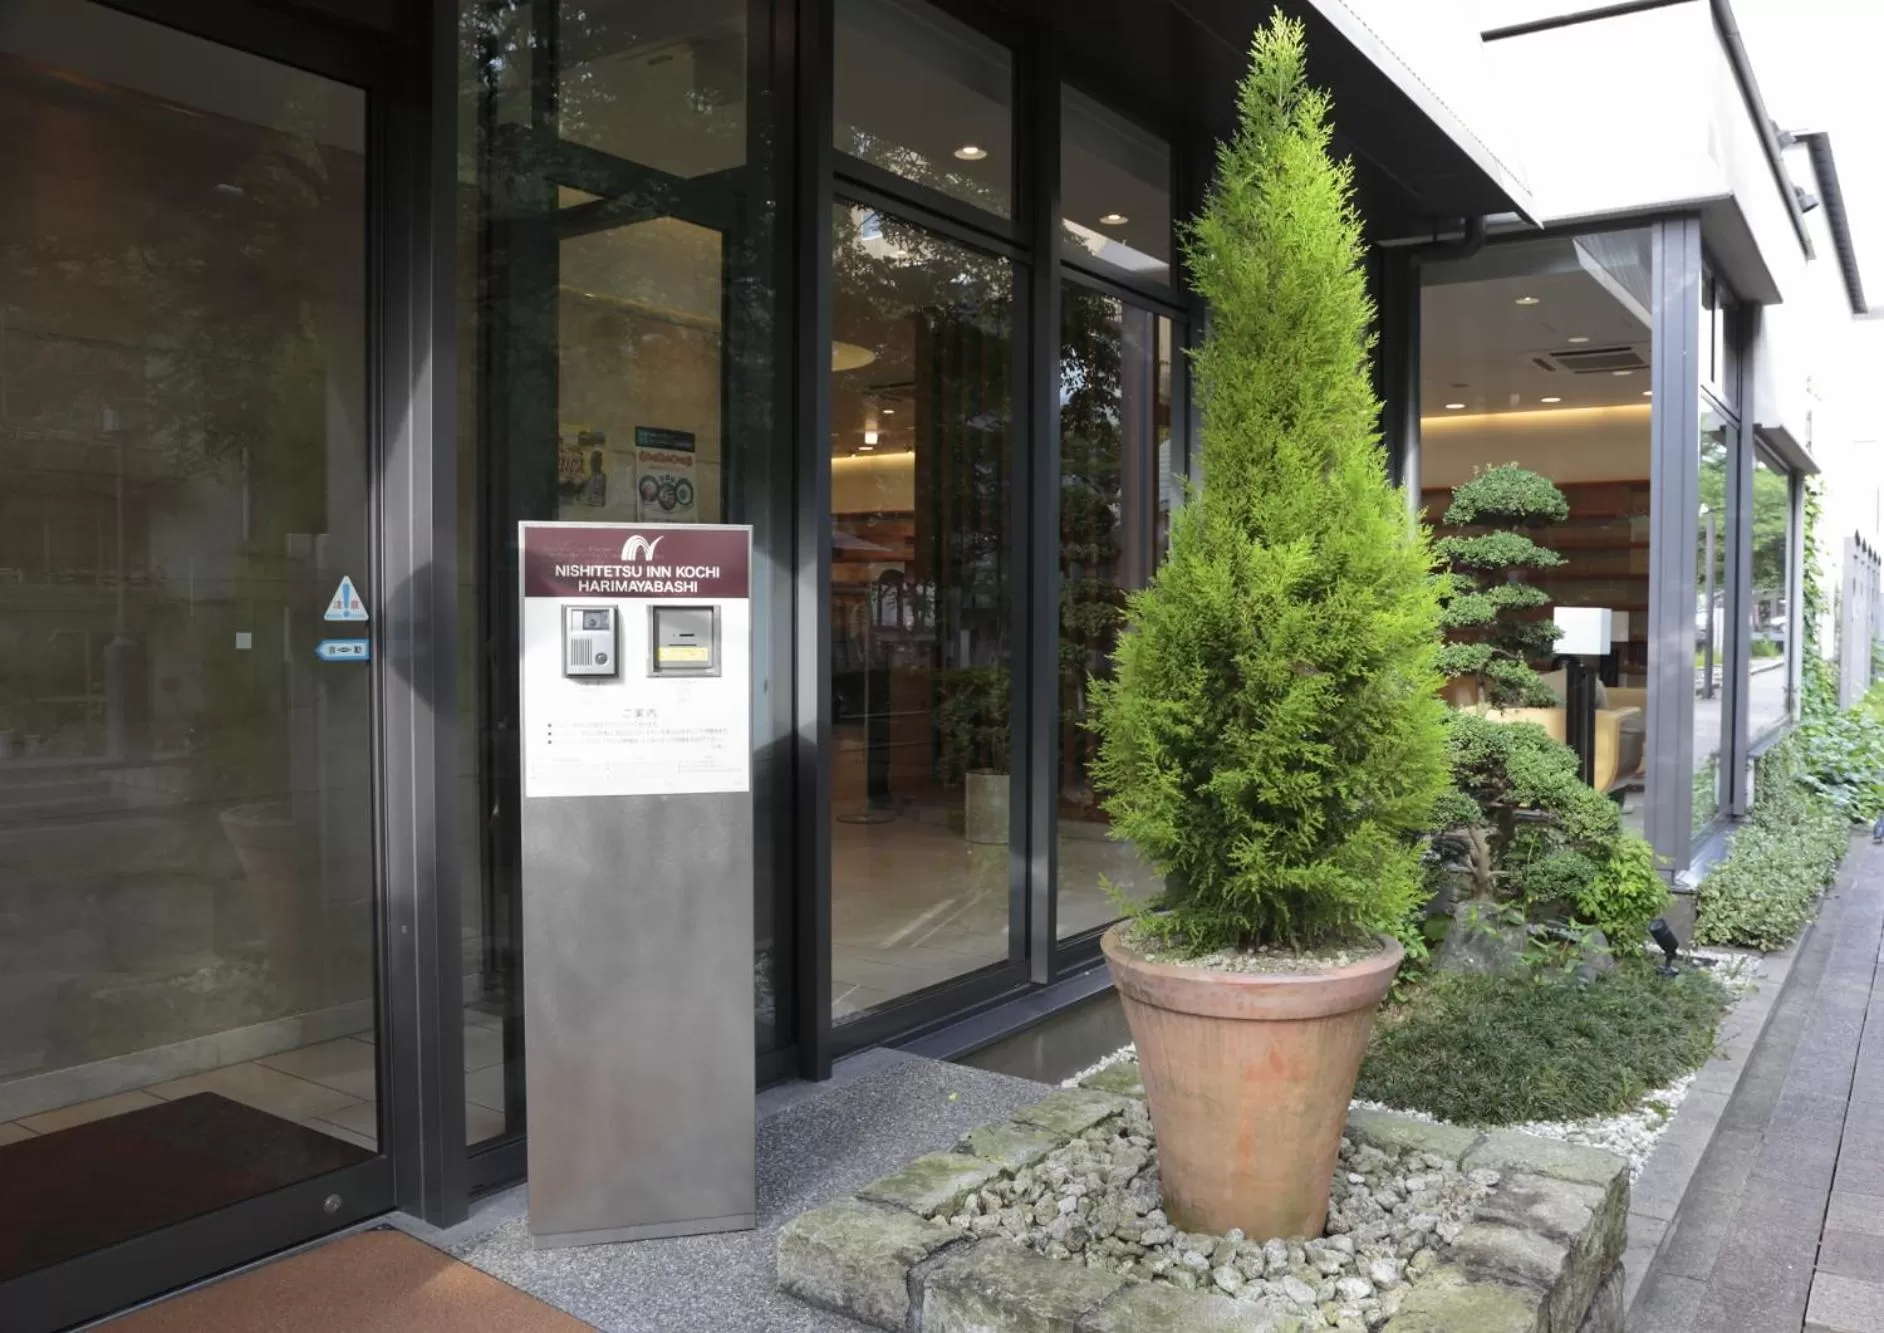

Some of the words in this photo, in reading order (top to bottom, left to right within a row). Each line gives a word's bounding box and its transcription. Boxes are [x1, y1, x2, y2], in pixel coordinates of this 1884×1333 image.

[555, 564, 641, 578] NISHITETSU
[646, 565, 672, 578] INN
[676, 565, 720, 579] KOCHI
[578, 580, 698, 593] HARIMAYABASHI
